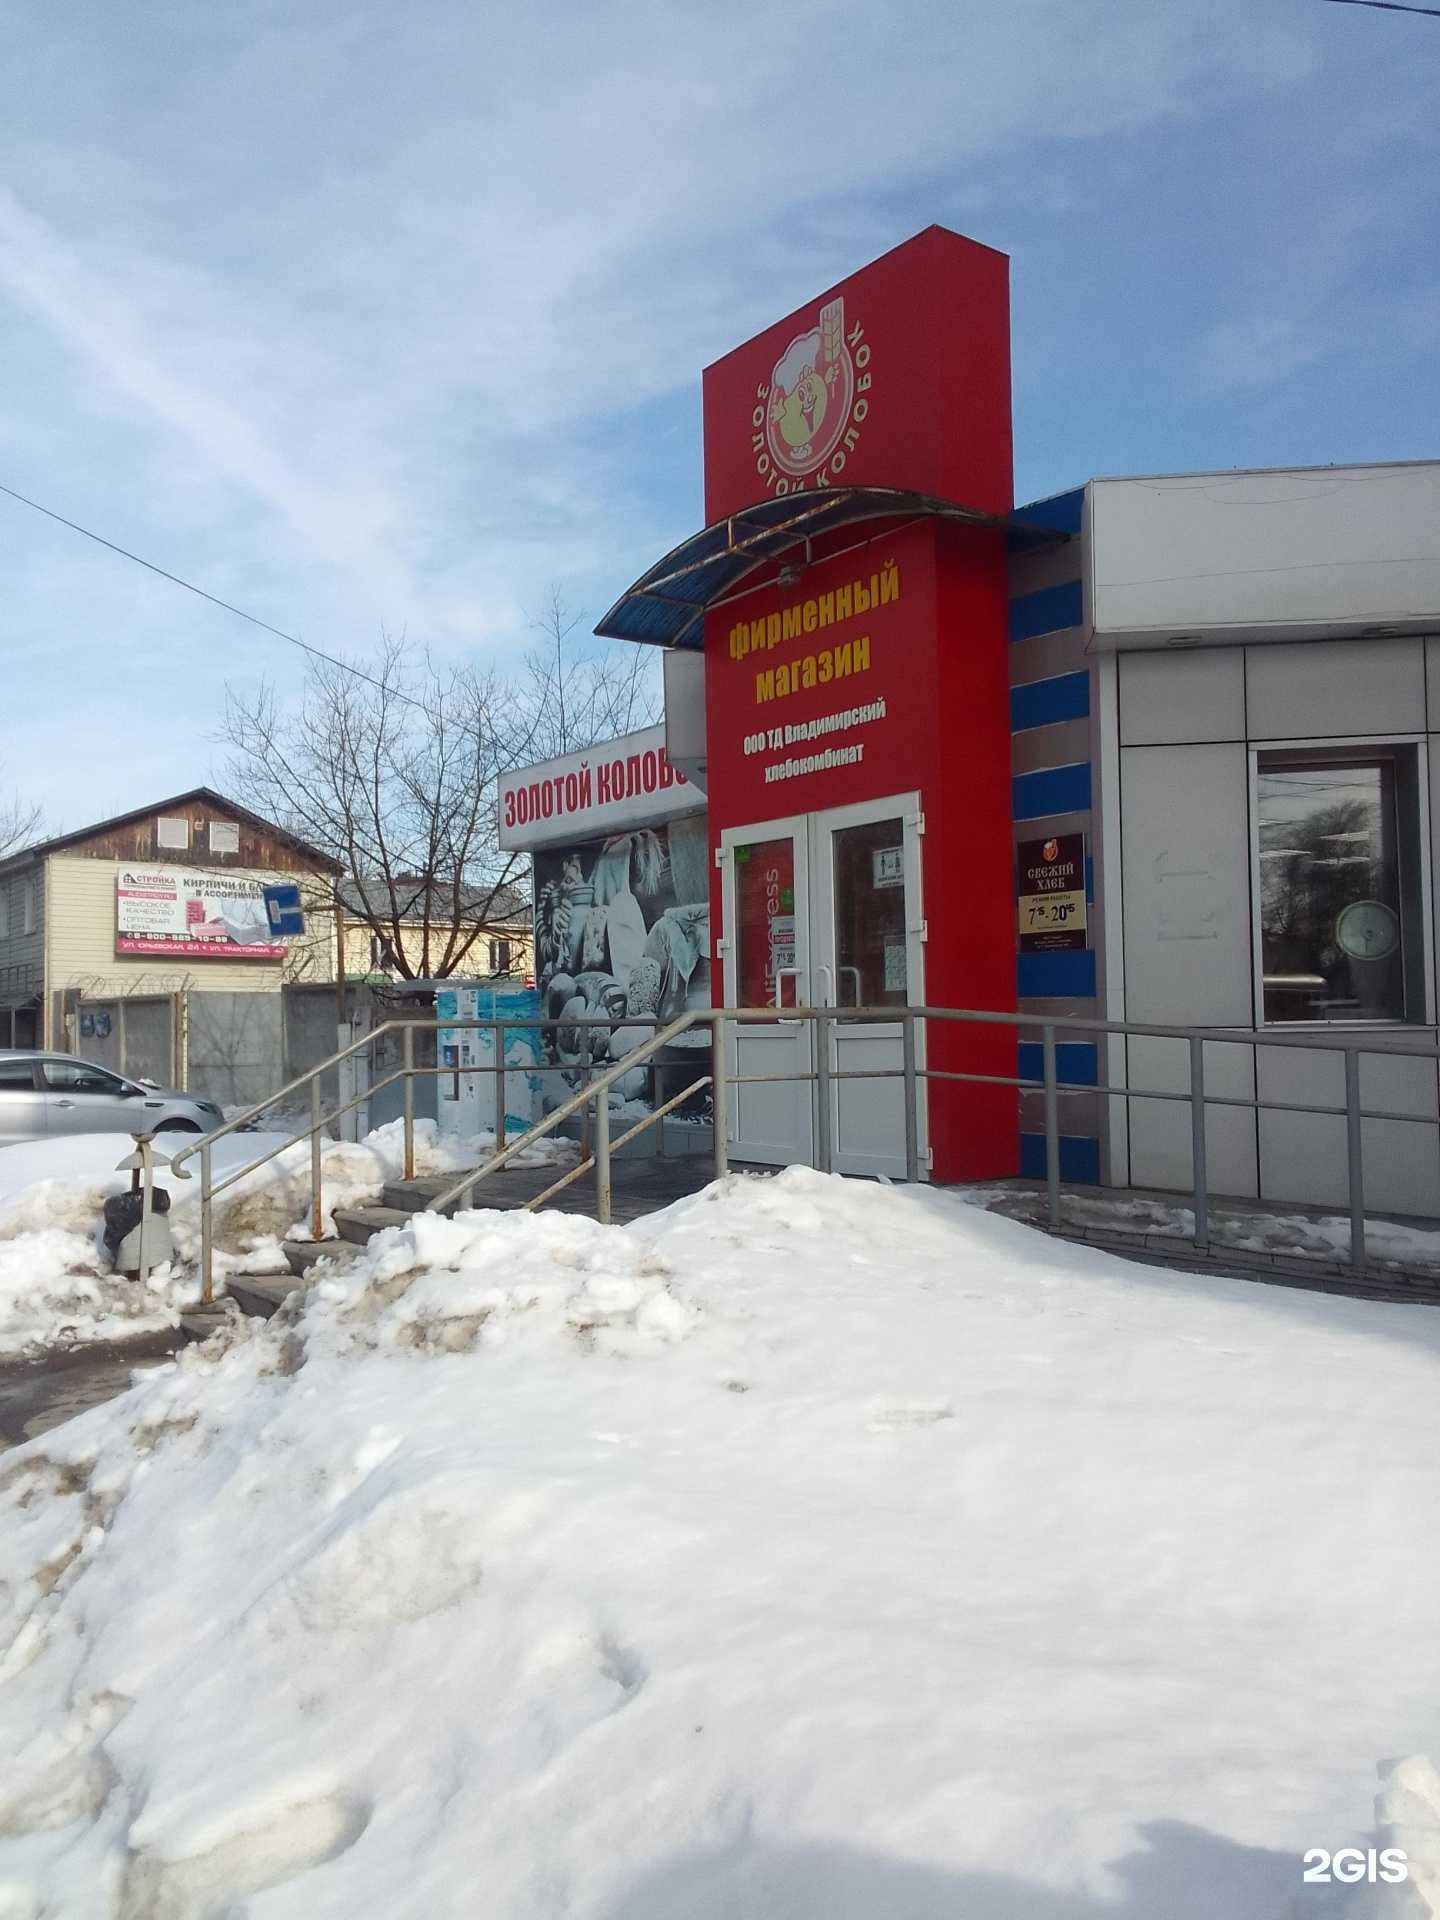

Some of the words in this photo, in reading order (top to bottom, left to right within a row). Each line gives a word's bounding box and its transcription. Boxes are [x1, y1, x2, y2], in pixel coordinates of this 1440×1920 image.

[752, 382, 805, 496] ЗОЛОТОЙ
[816, 319, 872, 488] КОЛОБОК
[756, 636, 871, 704] магазин
[743, 731, 765, 756] ООО
[767, 726, 785, 751] ТД
[785, 696, 887, 746] Владимирский
[765, 743, 865, 784] хлебокомбинат
[504, 760, 592, 828] ЗОЛОТОЙ
[597, 747, 689, 805] КОЛОБ
[183, 878, 235, 890] КИРПИЧИ
[1027, 862, 1075, 879] СВЕЖИЙ
[1036, 877, 1065, 891] ХЛЕБ
[204, 890, 265, 900] АССОРТИМЕН
